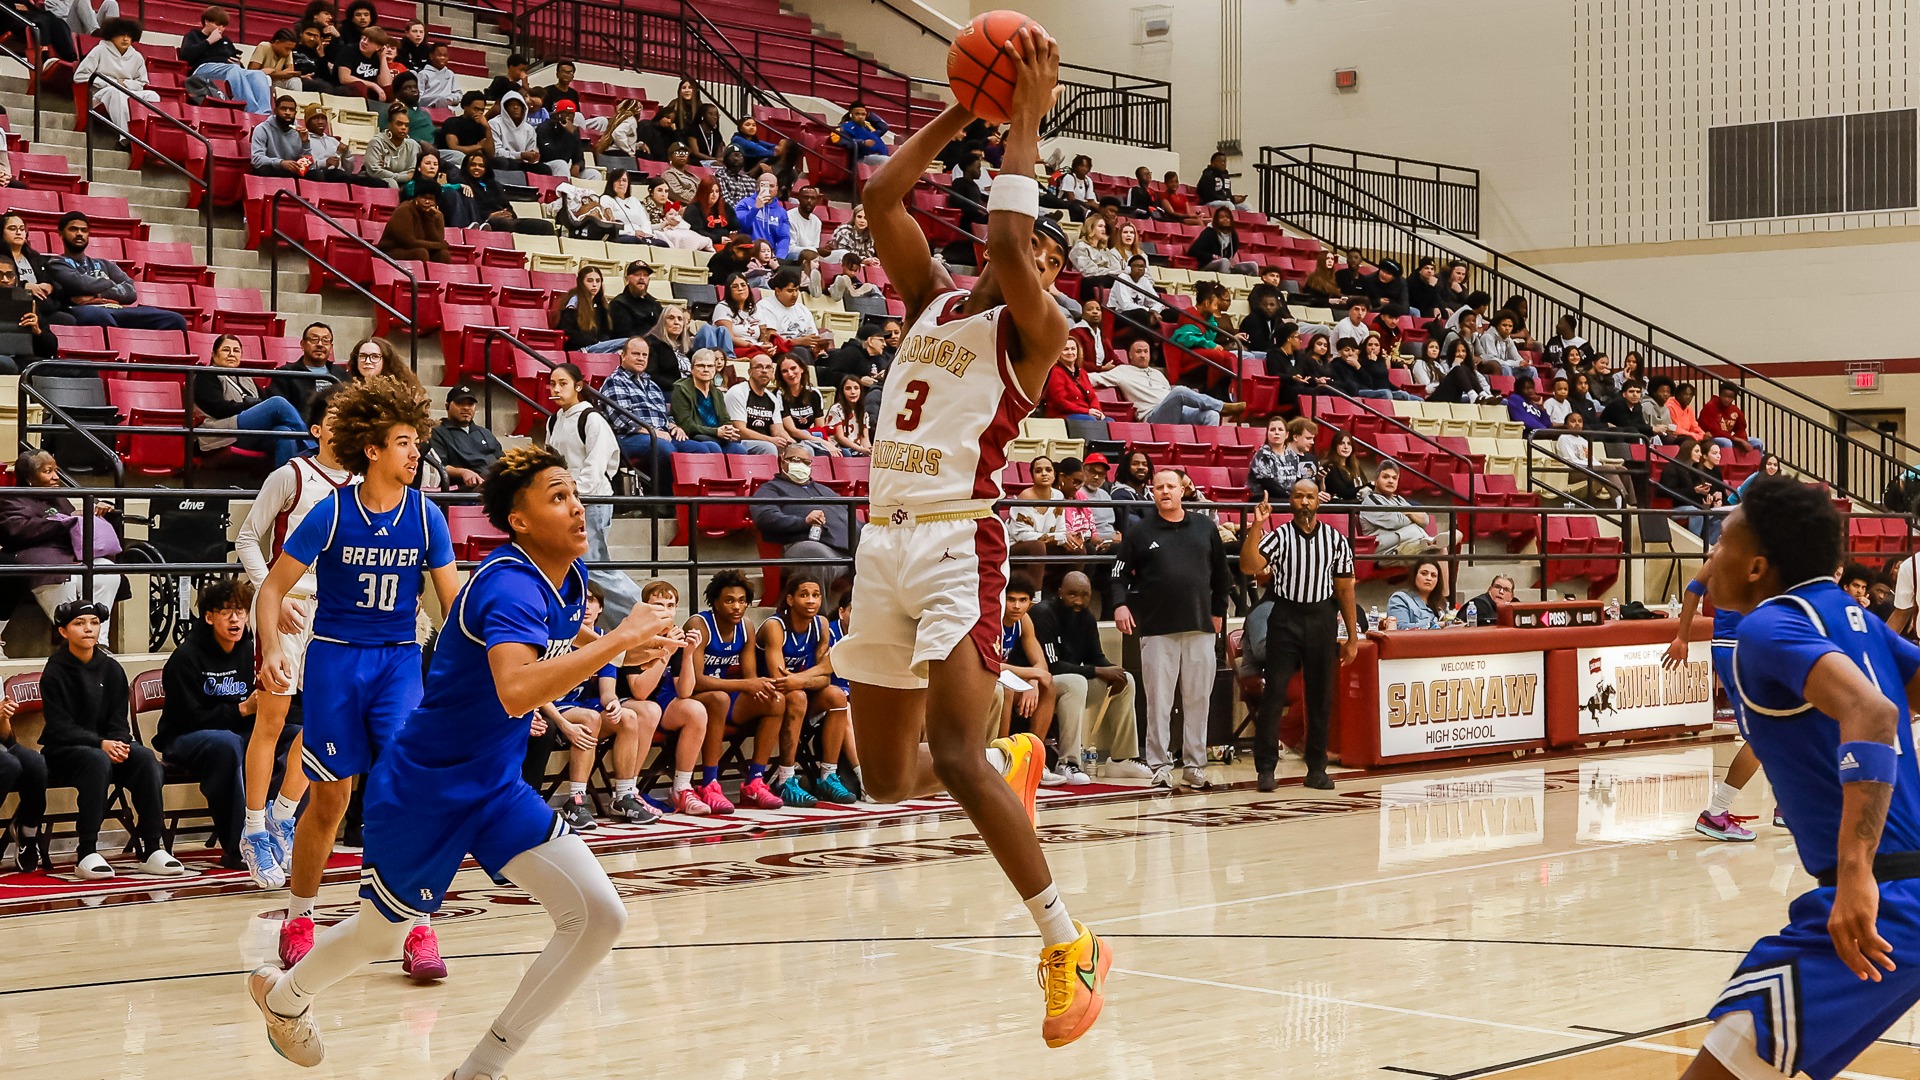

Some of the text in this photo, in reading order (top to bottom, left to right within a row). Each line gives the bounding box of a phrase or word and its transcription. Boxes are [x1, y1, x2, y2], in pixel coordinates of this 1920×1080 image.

[897, 335, 977, 378] ROUGH
[895, 379, 930, 432] 3
[873, 440, 942, 476] RIDERS
[179, 499, 206, 510] drive
[342, 546, 419, 567] BREWER
[356, 573, 399, 612] 30
[1549, 611, 1566, 626] POSS
[1441, 660, 1486, 672] WELCOME TO
[1624, 651, 1642, 660] HOME
[1643, 650, 1651, 660] OF
[1615, 660, 1709, 709] ROUGH RIDERS
[1388, 674, 1537, 728] SAGINAW
[1426, 725, 1496, 744] HIGH SCHOOL
